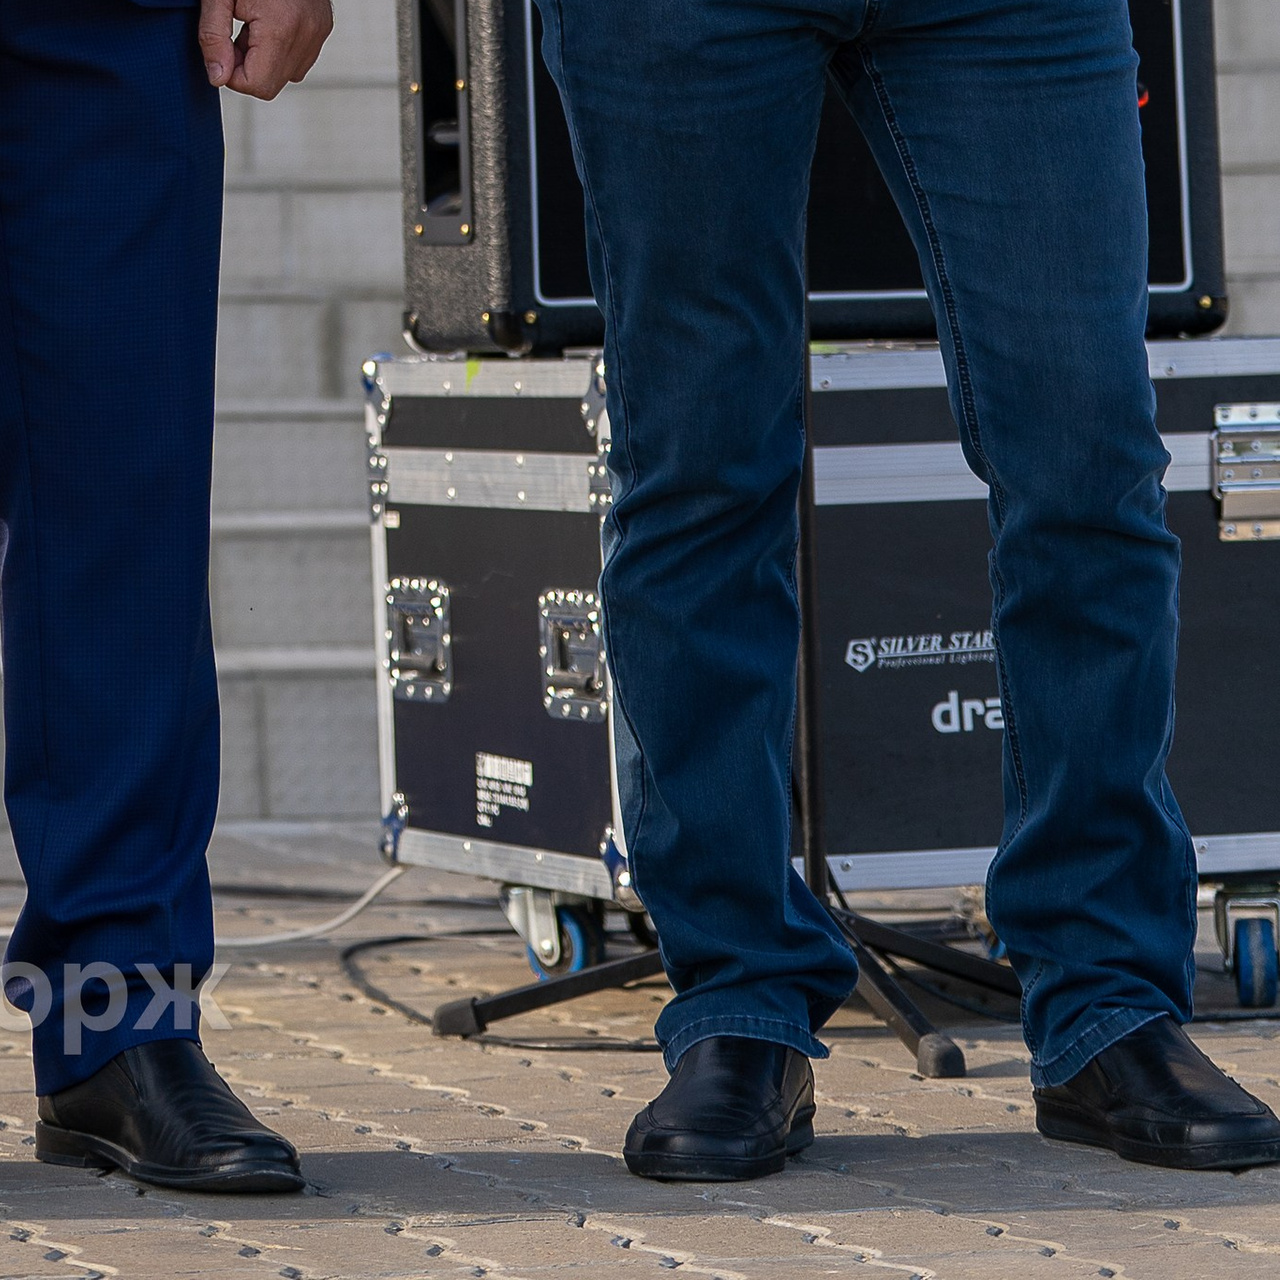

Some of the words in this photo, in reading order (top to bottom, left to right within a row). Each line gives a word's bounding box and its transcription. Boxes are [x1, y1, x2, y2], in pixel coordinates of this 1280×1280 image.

[877, 634, 943, 655] SILVER
[949, 630, 996, 651] STAR
[877, 655, 946, 669] Professional
